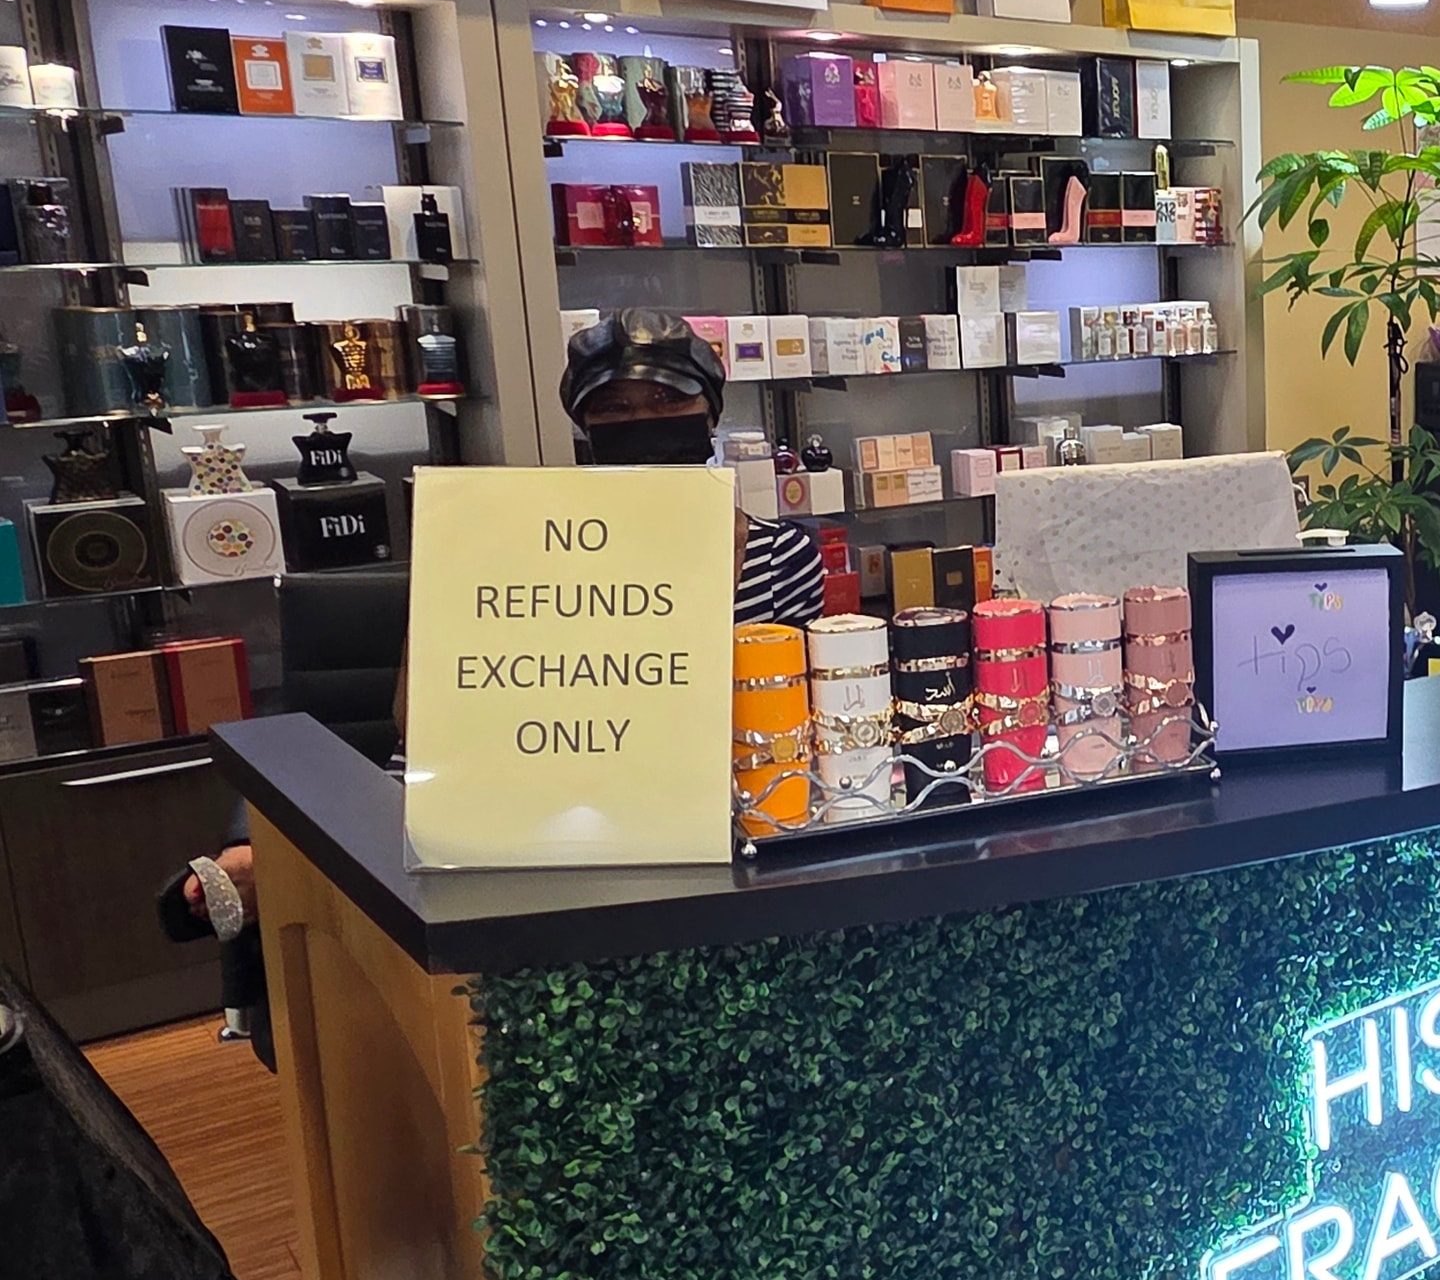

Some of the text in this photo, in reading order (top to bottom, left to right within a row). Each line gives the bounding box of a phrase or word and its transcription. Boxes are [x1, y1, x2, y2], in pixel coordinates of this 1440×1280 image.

[310, 450, 343, 466] FiDi
[319, 514, 366, 538] FiDi
[545, 519, 608, 551] NO
[477, 583, 674, 618] REFUNDS
[457, 652, 689, 689] EXCHANGE
[516, 719, 630, 754] ONLY
